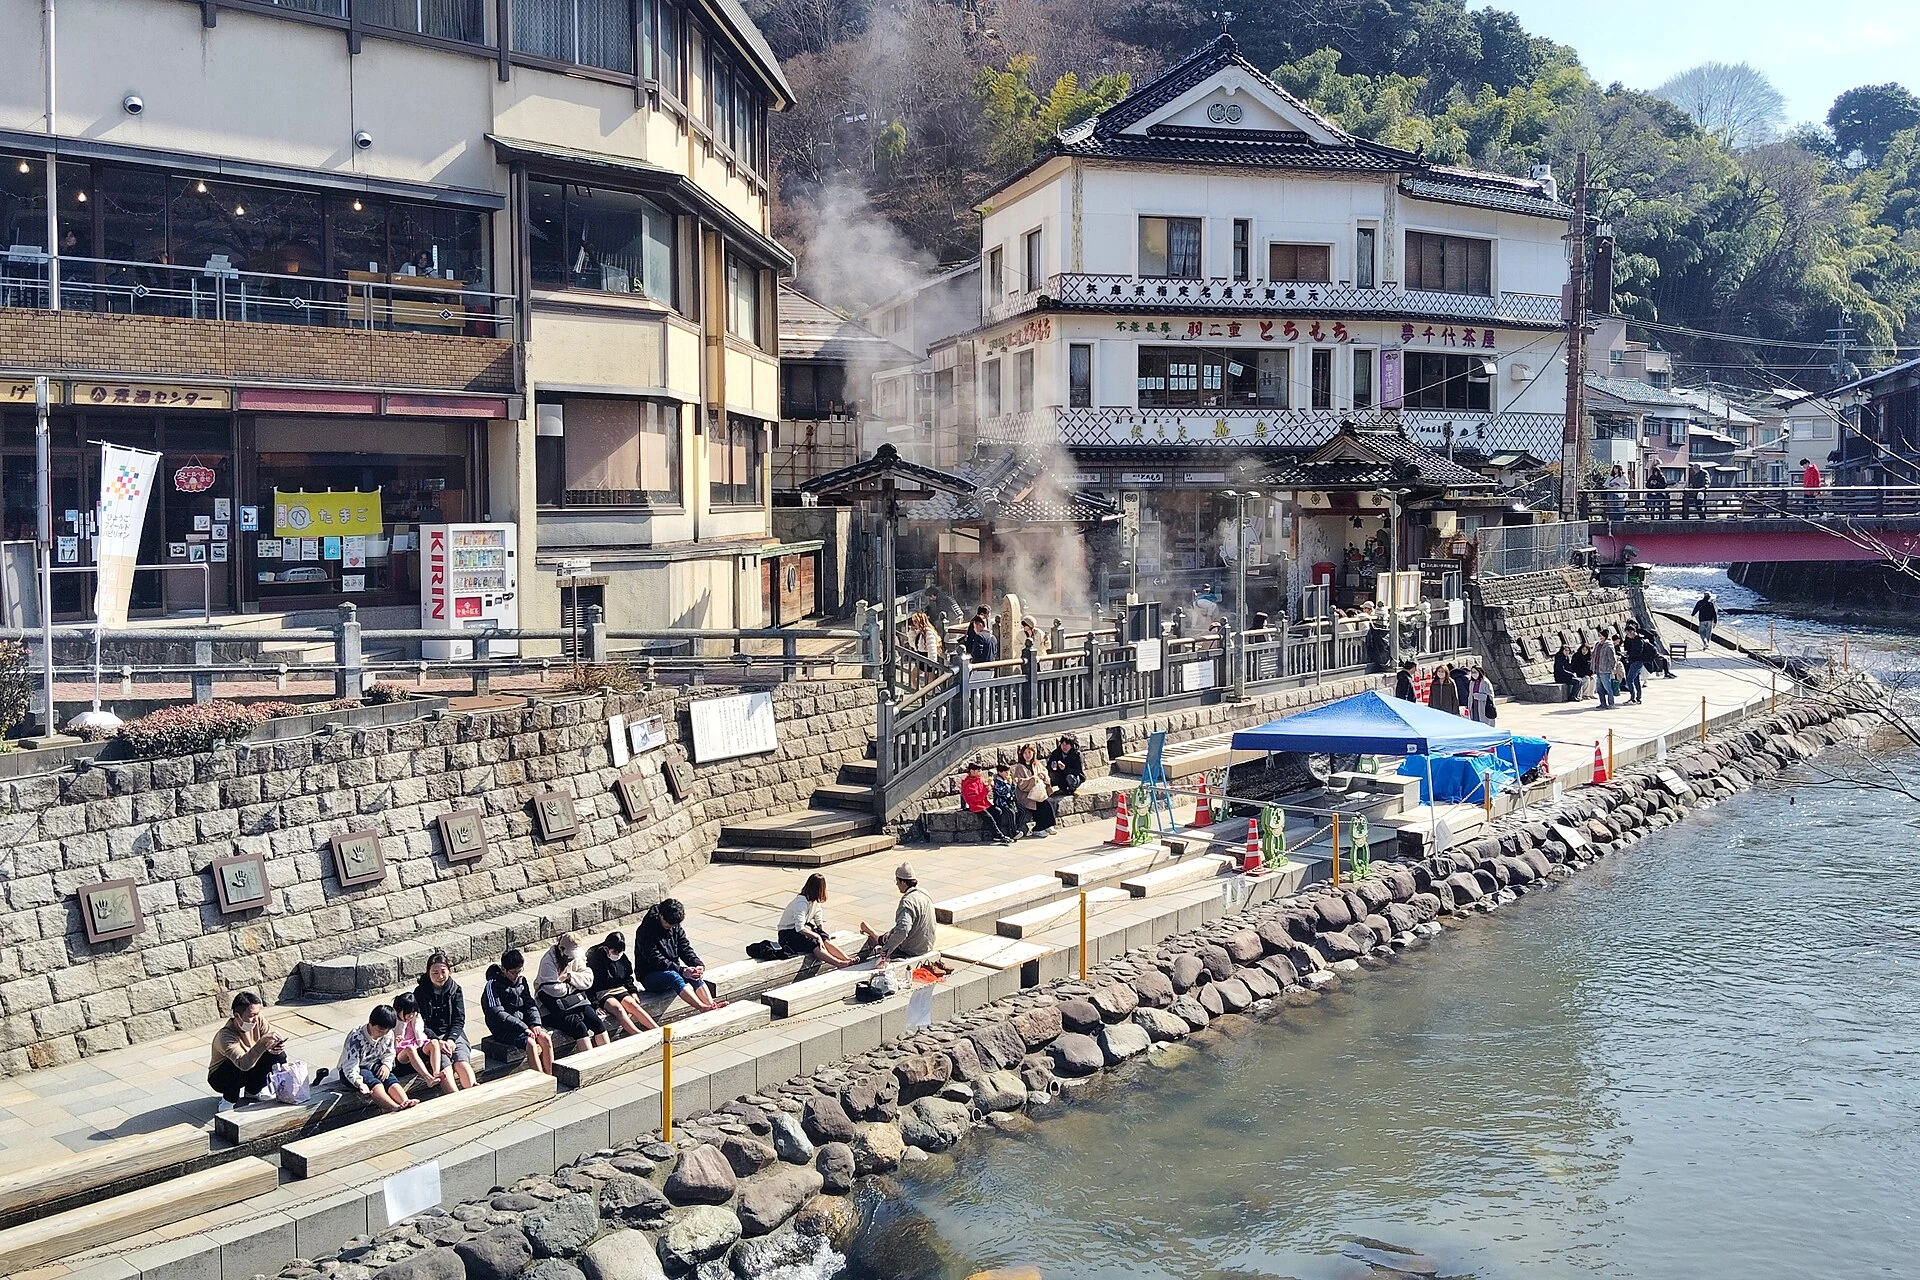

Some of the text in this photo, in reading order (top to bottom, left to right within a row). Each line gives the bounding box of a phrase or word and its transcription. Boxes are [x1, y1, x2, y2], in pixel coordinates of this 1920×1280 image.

[1187, 320, 1242, 339] 羽二重
[1259, 320, 1348, 342] とちもち
[1401, 323, 1496, 349] 夢千代茶屋
[10, 385, 33, 400] げ
[113, 388, 213, 406] 荒湯センター
[106, 513, 130, 522] ひょうご
[318, 508, 368, 524] たまご
[104, 522, 130, 531] フィールド
[430, 531, 445, 620] KIRIN
